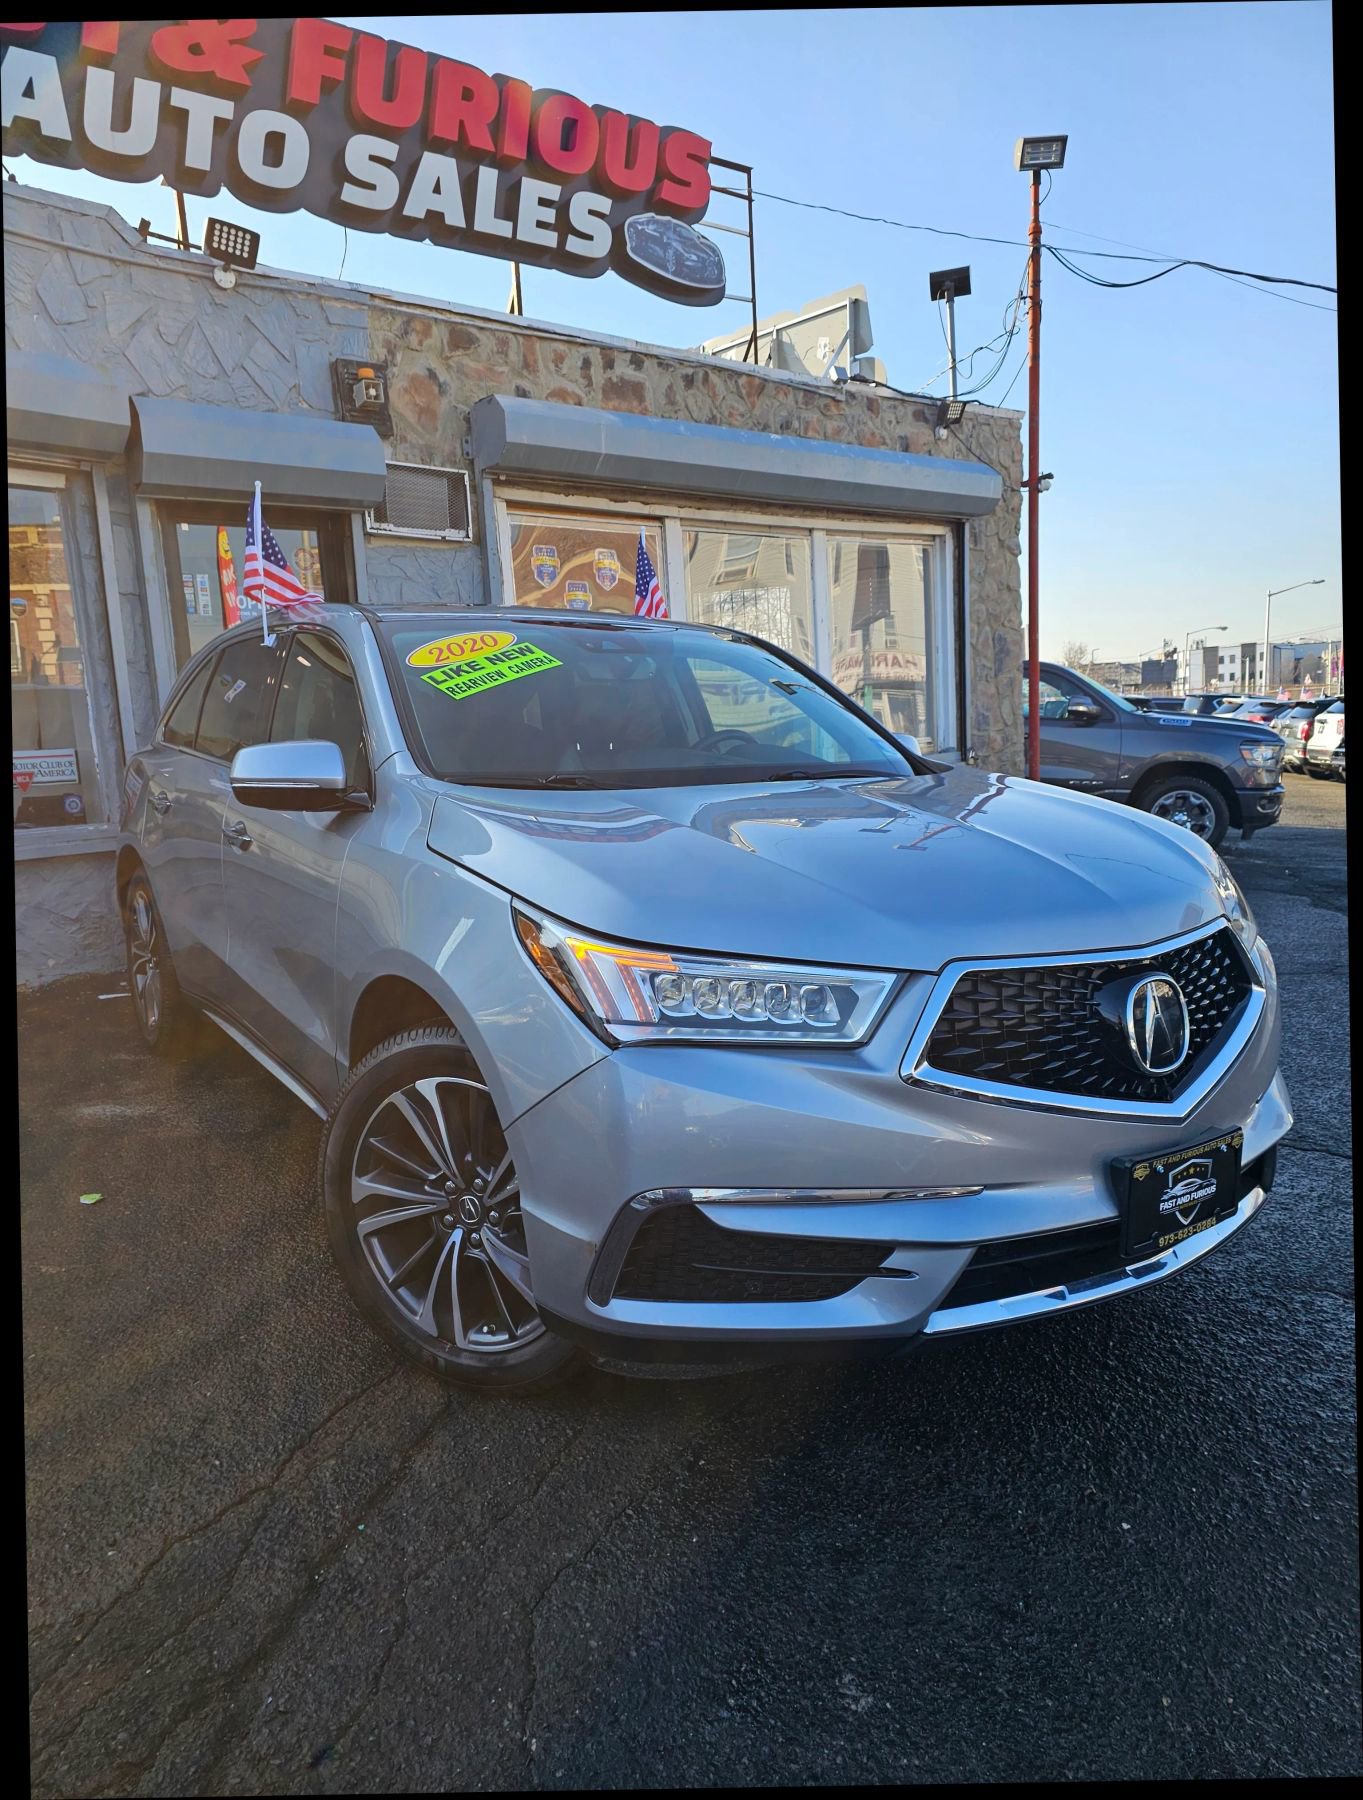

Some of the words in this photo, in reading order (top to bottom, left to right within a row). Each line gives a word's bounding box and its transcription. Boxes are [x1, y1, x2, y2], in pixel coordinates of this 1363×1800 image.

[287, 18, 713, 209] FURIOUS
[1, 45, 311, 189] AUTO
[340, 133, 613, 259] SALES
[427, 660, 485, 685] LIKE
[484, 645, 536, 665] NEW
[428, 633, 498, 664] 2020
[445, 669, 508, 696] REARVIEW
[507, 656, 557, 674] CAMERA
[1153, 1159, 1168, 1168] FAST
[1169, 1155, 1181, 1164] AND
[1181, 1146, 1204, 1159] FURIOUS
[1160, 1199, 1176, 1211] FAST
[1176, 1195, 1191, 1206] AND
[1190, 1184, 1217, 1200] FURIOUS
